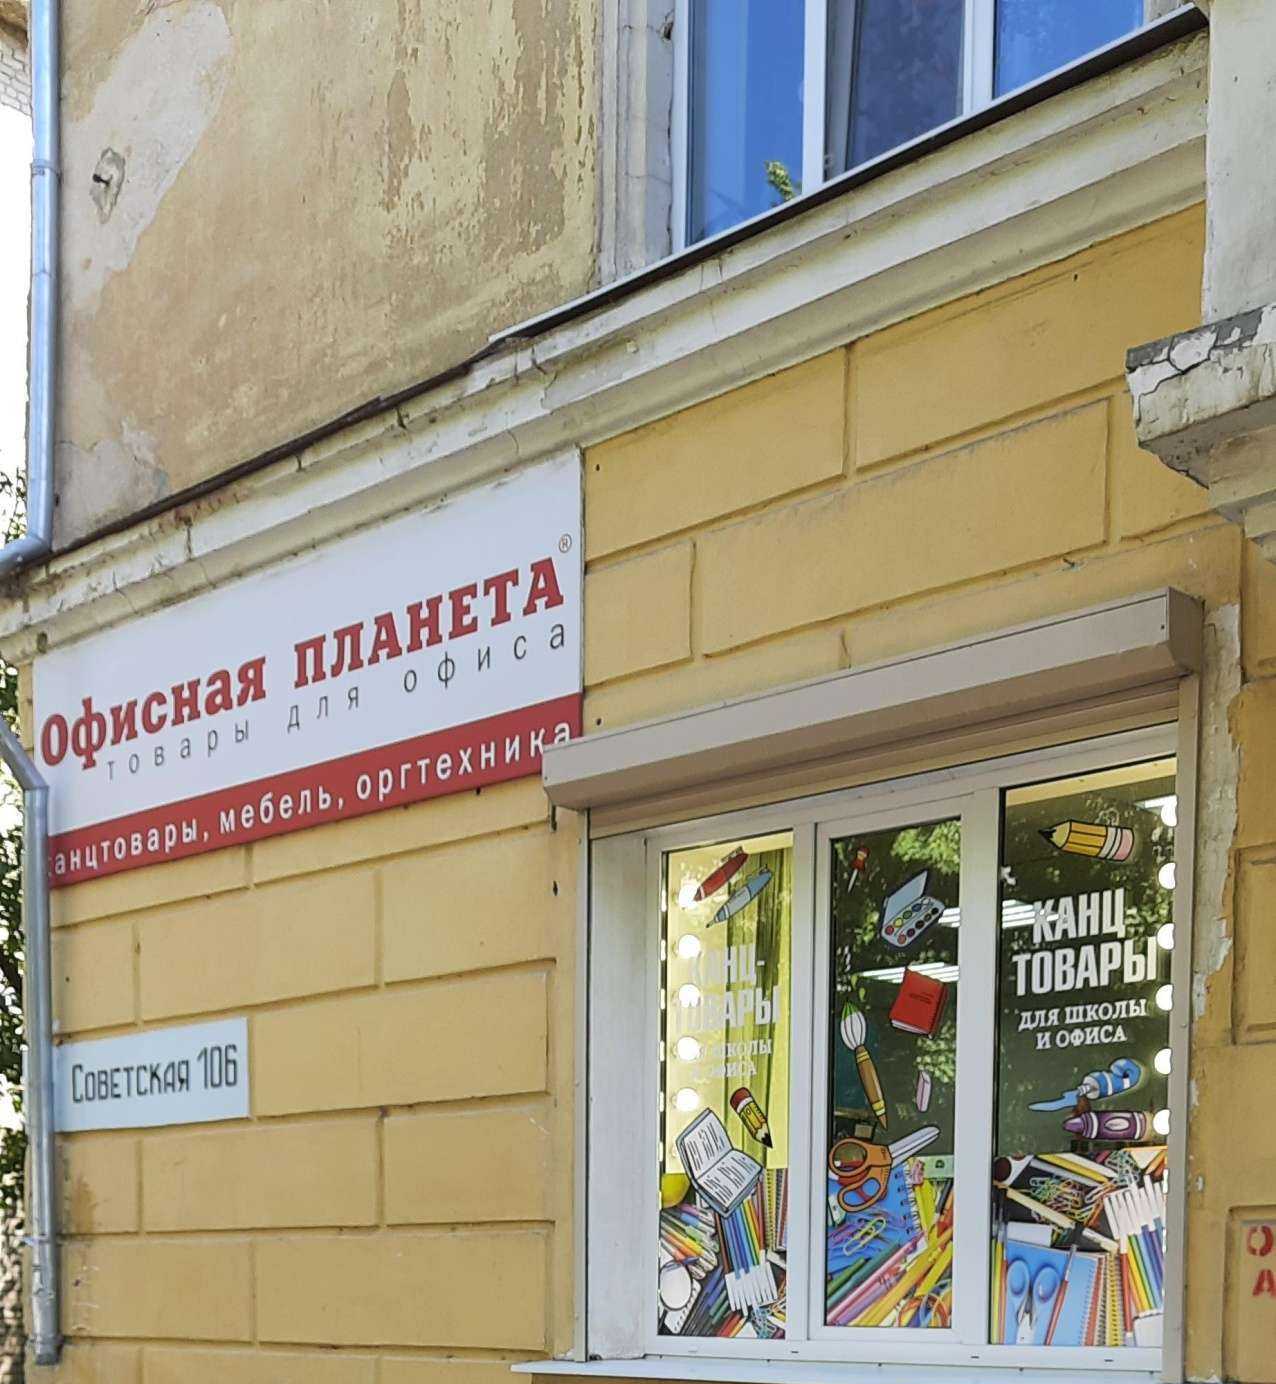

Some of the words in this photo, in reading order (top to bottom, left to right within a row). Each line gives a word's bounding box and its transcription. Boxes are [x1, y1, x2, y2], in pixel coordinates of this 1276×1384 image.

[41, 655, 266, 770] Офисная
[294, 557, 564, 689] ПЛАНЕТА
[107, 720, 249, 780] товары
[287, 686, 360, 734] для
[403, 623, 565, 693] офиса
[47, 818, 209, 877] анцтовары,
[219, 783, 344, 834] мебель,
[356, 721, 572, 802] оргтехника
[1012, 936, 1158, 996] ТОВАРЫ
[1018, 1008, 1060, 1032] ДЛЯ
[1064, 998, 1148, 1024] ШКОЛЫ
[1036, 1032, 1051, 1050] И
[1055, 1025, 1128, 1048] ОФИСА
[196, 1043, 238, 1090] 106
